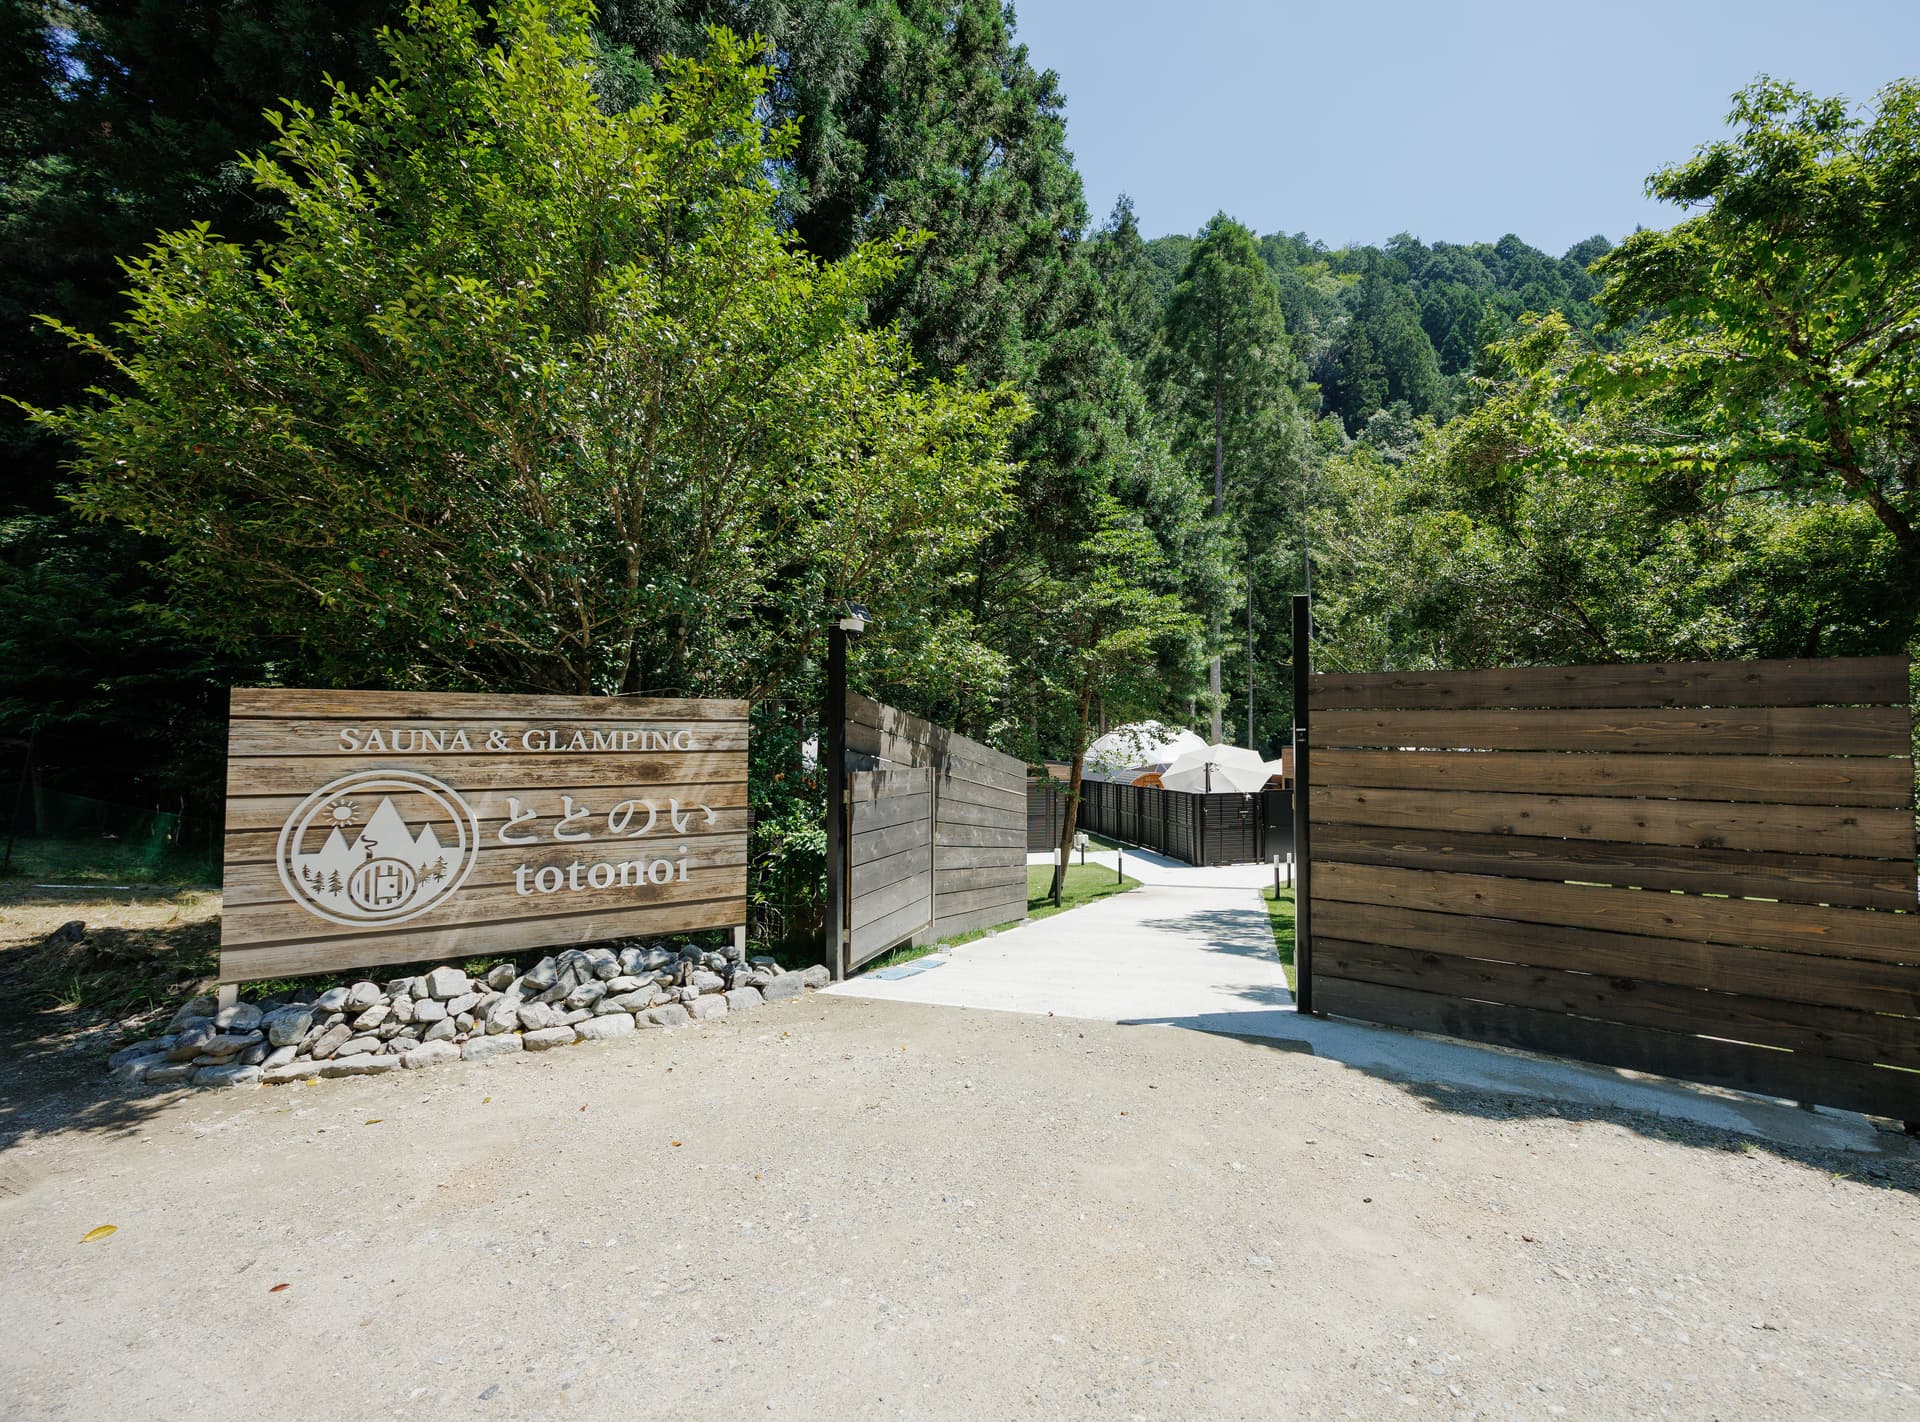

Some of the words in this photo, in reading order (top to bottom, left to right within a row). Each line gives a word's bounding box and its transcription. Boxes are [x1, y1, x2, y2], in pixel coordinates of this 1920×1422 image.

[338, 727, 473, 752] SAUNA
[485, 729, 511, 751] &
[522, 729, 693, 751] GLAMPING
[498, 795, 717, 844] ととのい
[512, 845, 690, 896] totonoi
